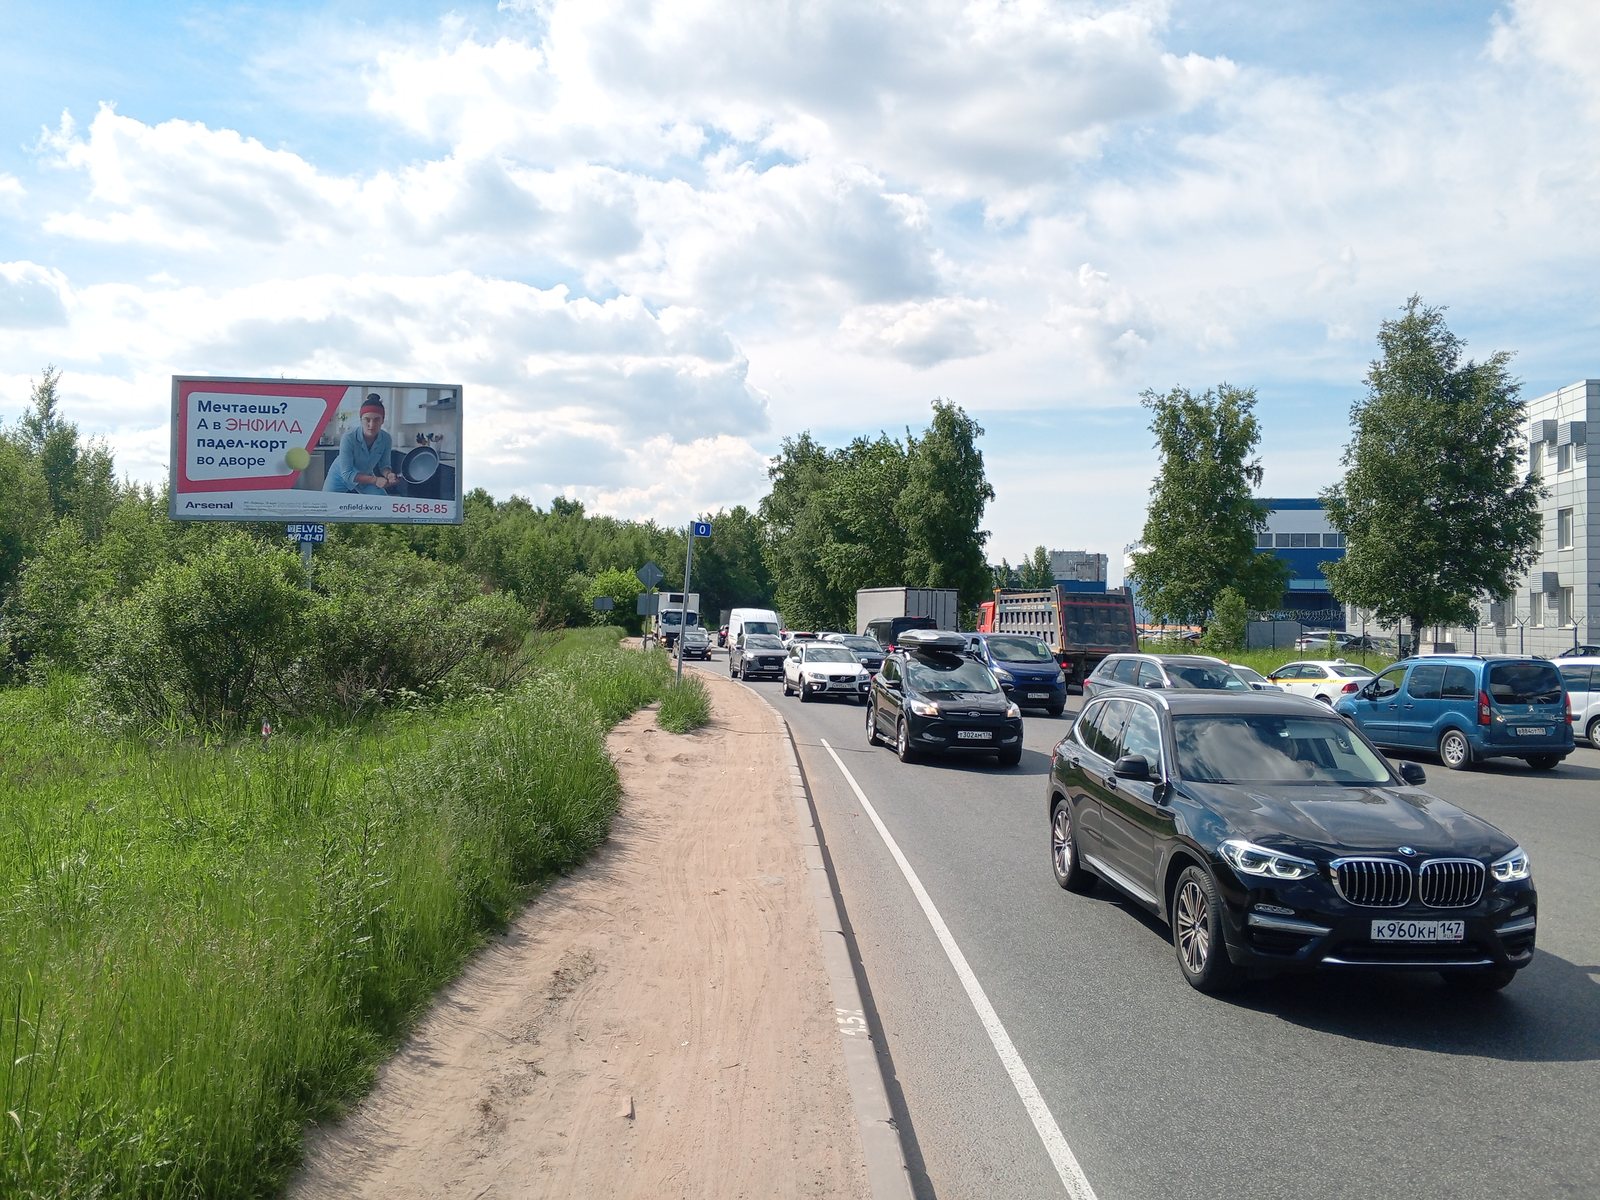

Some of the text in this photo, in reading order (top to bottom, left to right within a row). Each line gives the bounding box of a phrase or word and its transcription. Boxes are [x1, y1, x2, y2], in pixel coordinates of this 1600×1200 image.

[197, 400, 288, 414] Мечтаешь?
[196, 418, 302, 434] А в ЭНФИЛД
[196, 438, 287, 452] падел-корт
[196, 456, 266, 469] во дворе
[185, 501, 233, 509] Arsenal
[339, 503, 382, 511] enfield-kv.ru
[392, 503, 448, 514] 561-58-85
[295, 524, 324, 533] ELVIS
[699, 525, 706, 535] 0
[1439, 922, 1461, 934] 147
